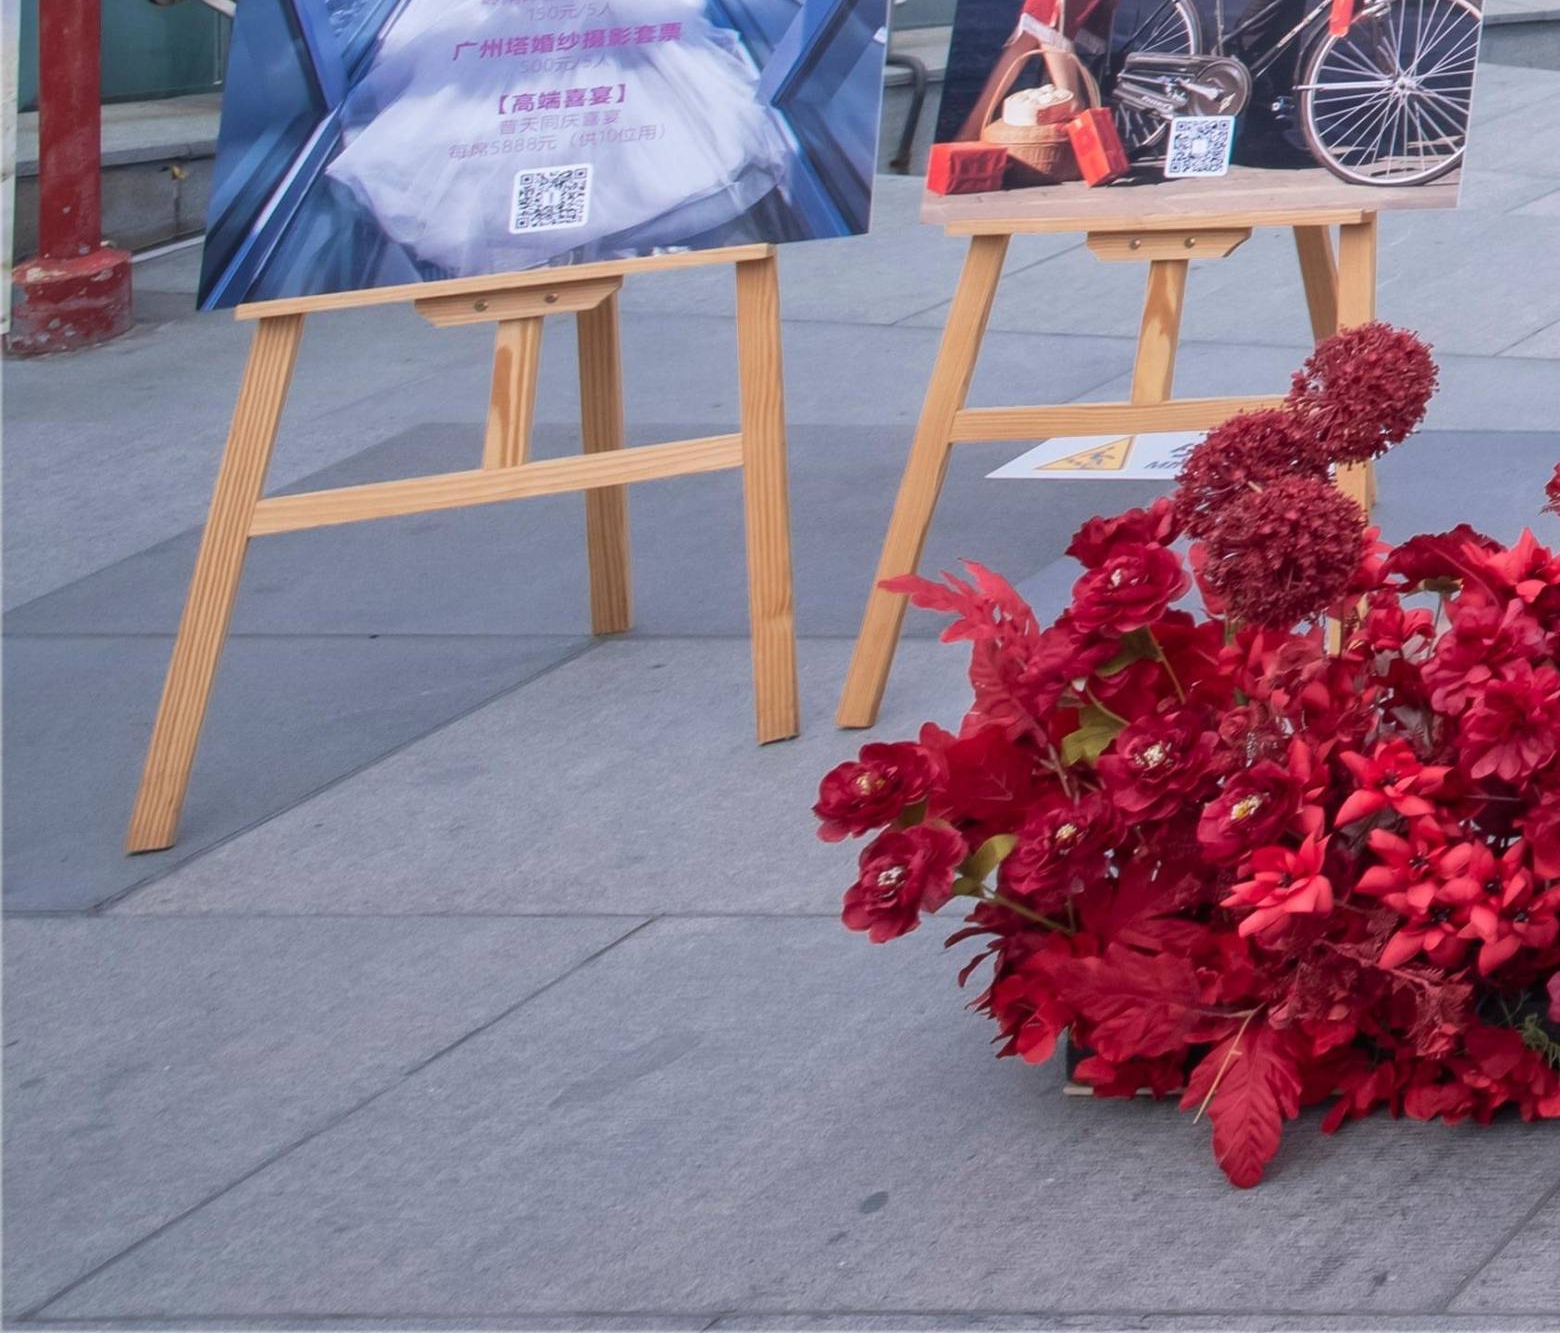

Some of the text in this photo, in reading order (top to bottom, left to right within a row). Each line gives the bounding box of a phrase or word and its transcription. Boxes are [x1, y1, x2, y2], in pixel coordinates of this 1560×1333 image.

[452, 21, 684, 61] 广州塔婚纱摄影套票
